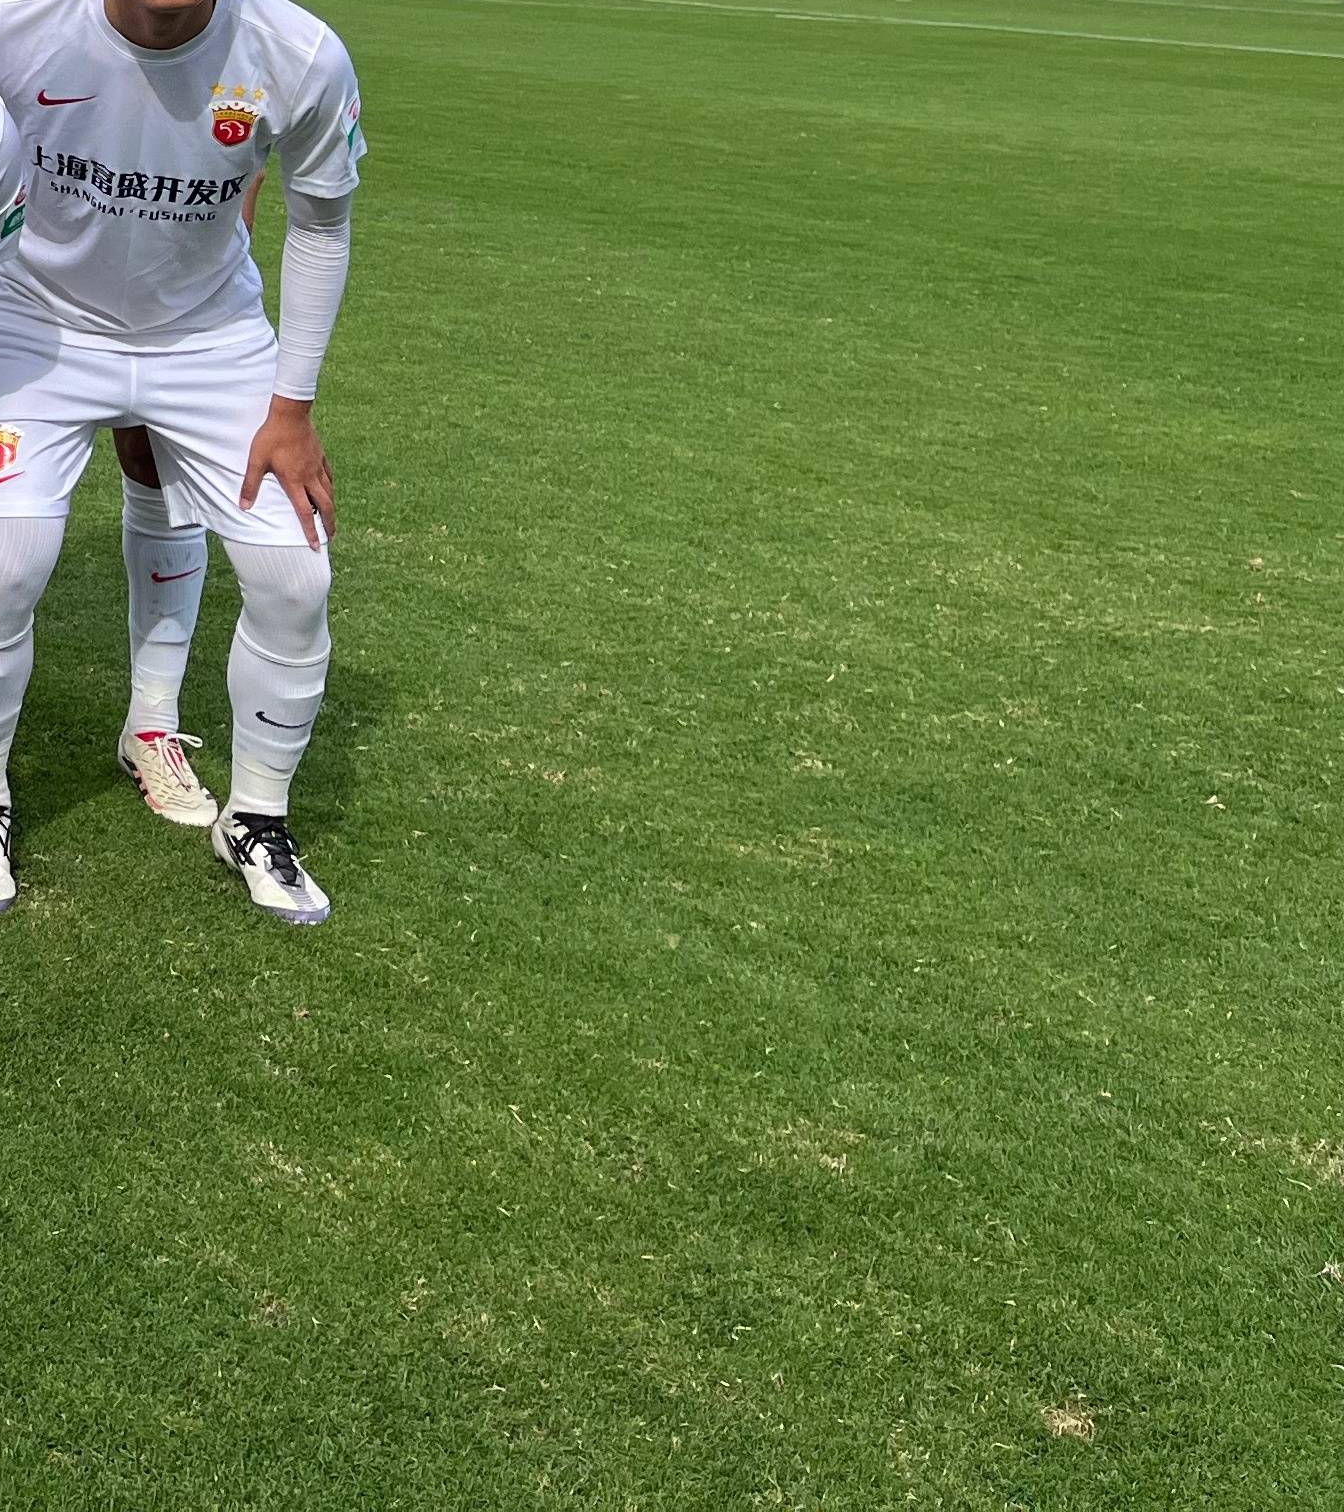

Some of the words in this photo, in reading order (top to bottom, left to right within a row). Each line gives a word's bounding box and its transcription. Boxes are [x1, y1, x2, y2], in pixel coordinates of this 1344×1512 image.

[31, 145, 249, 206] 上海富盛开发区
[50, 181, 124, 216] SHANGHAI
[138, 210, 216, 223] FUSHENG
